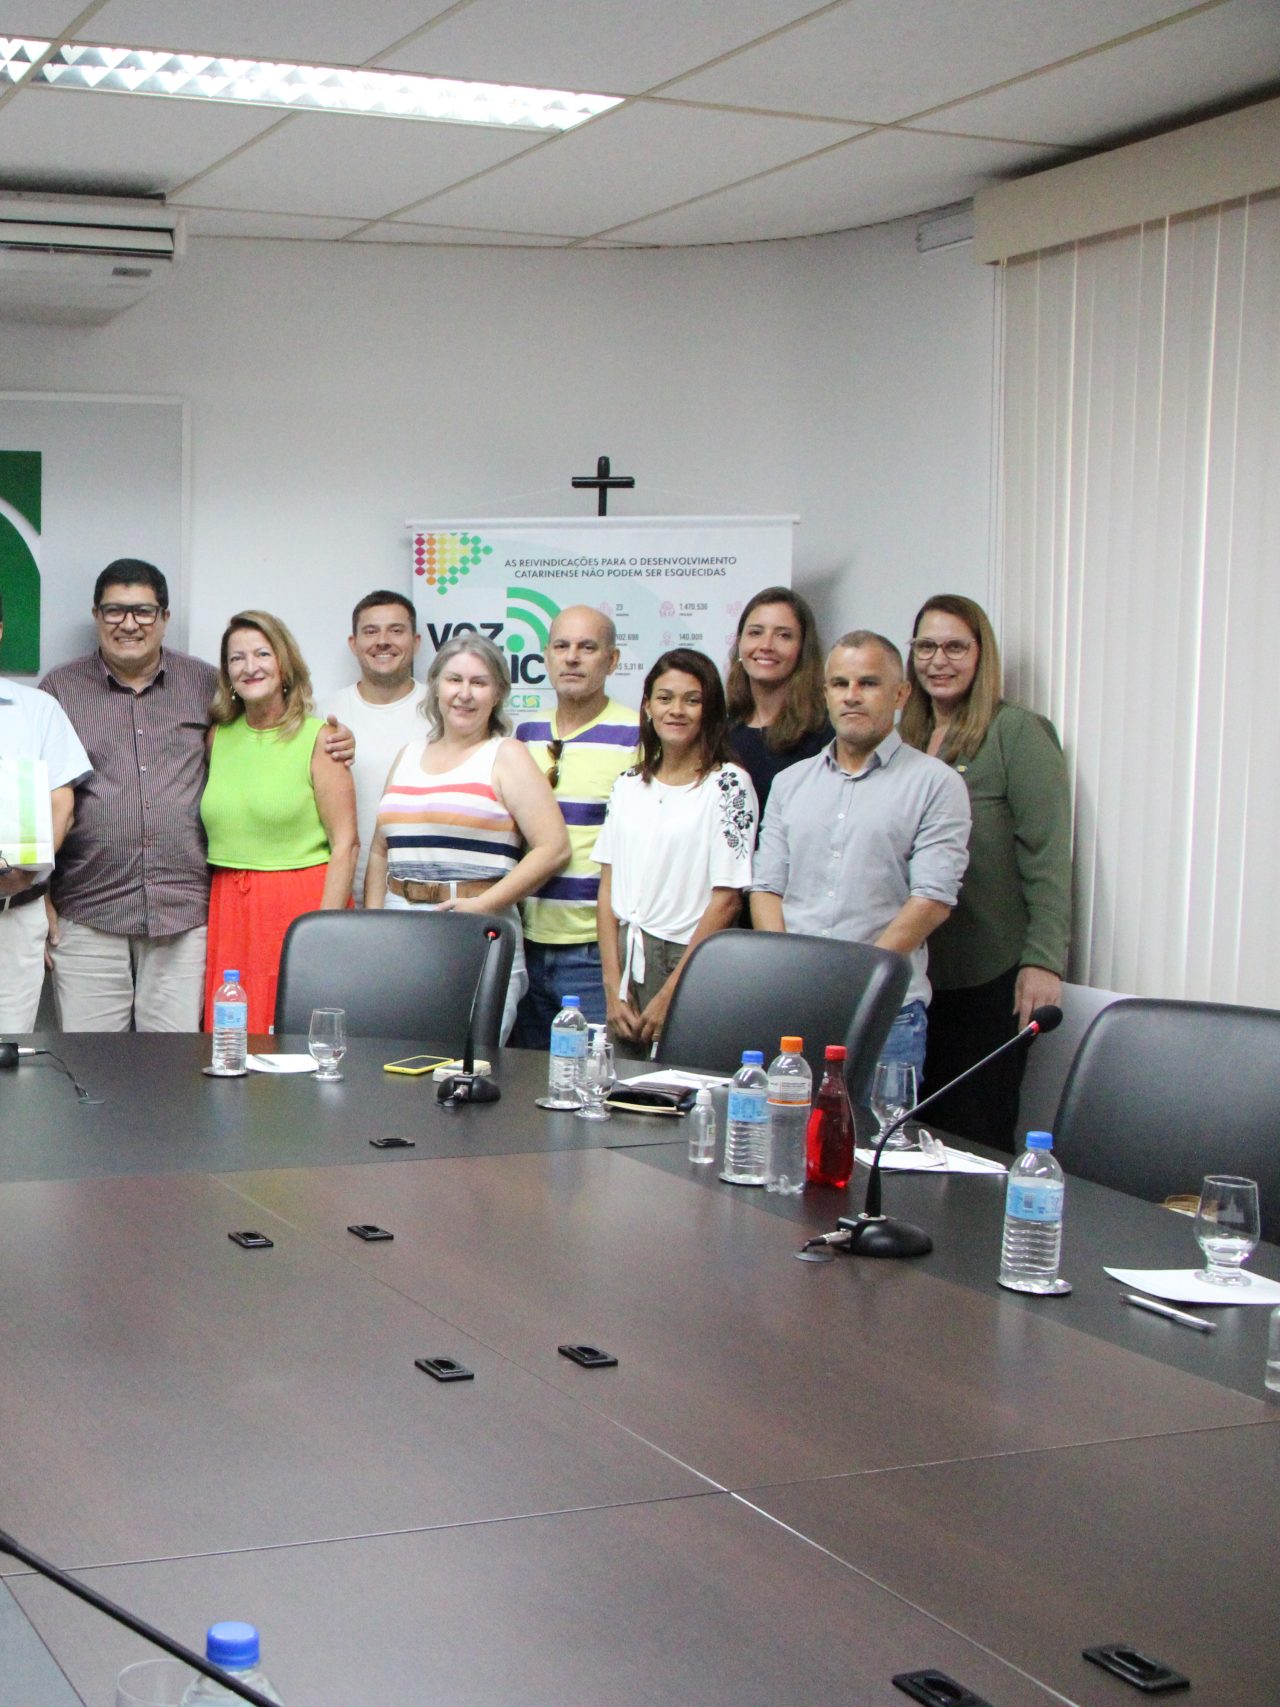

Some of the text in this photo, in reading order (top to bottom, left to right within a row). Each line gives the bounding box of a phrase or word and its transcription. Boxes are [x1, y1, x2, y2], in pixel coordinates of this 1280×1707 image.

[504, 556, 737, 568] AS REIVINDICAÇÕES PARA O DESENVOLVIMENTO
[514, 567, 726, 578] CATARINENSE NÃO PODEM SER ESQUECIDAS
